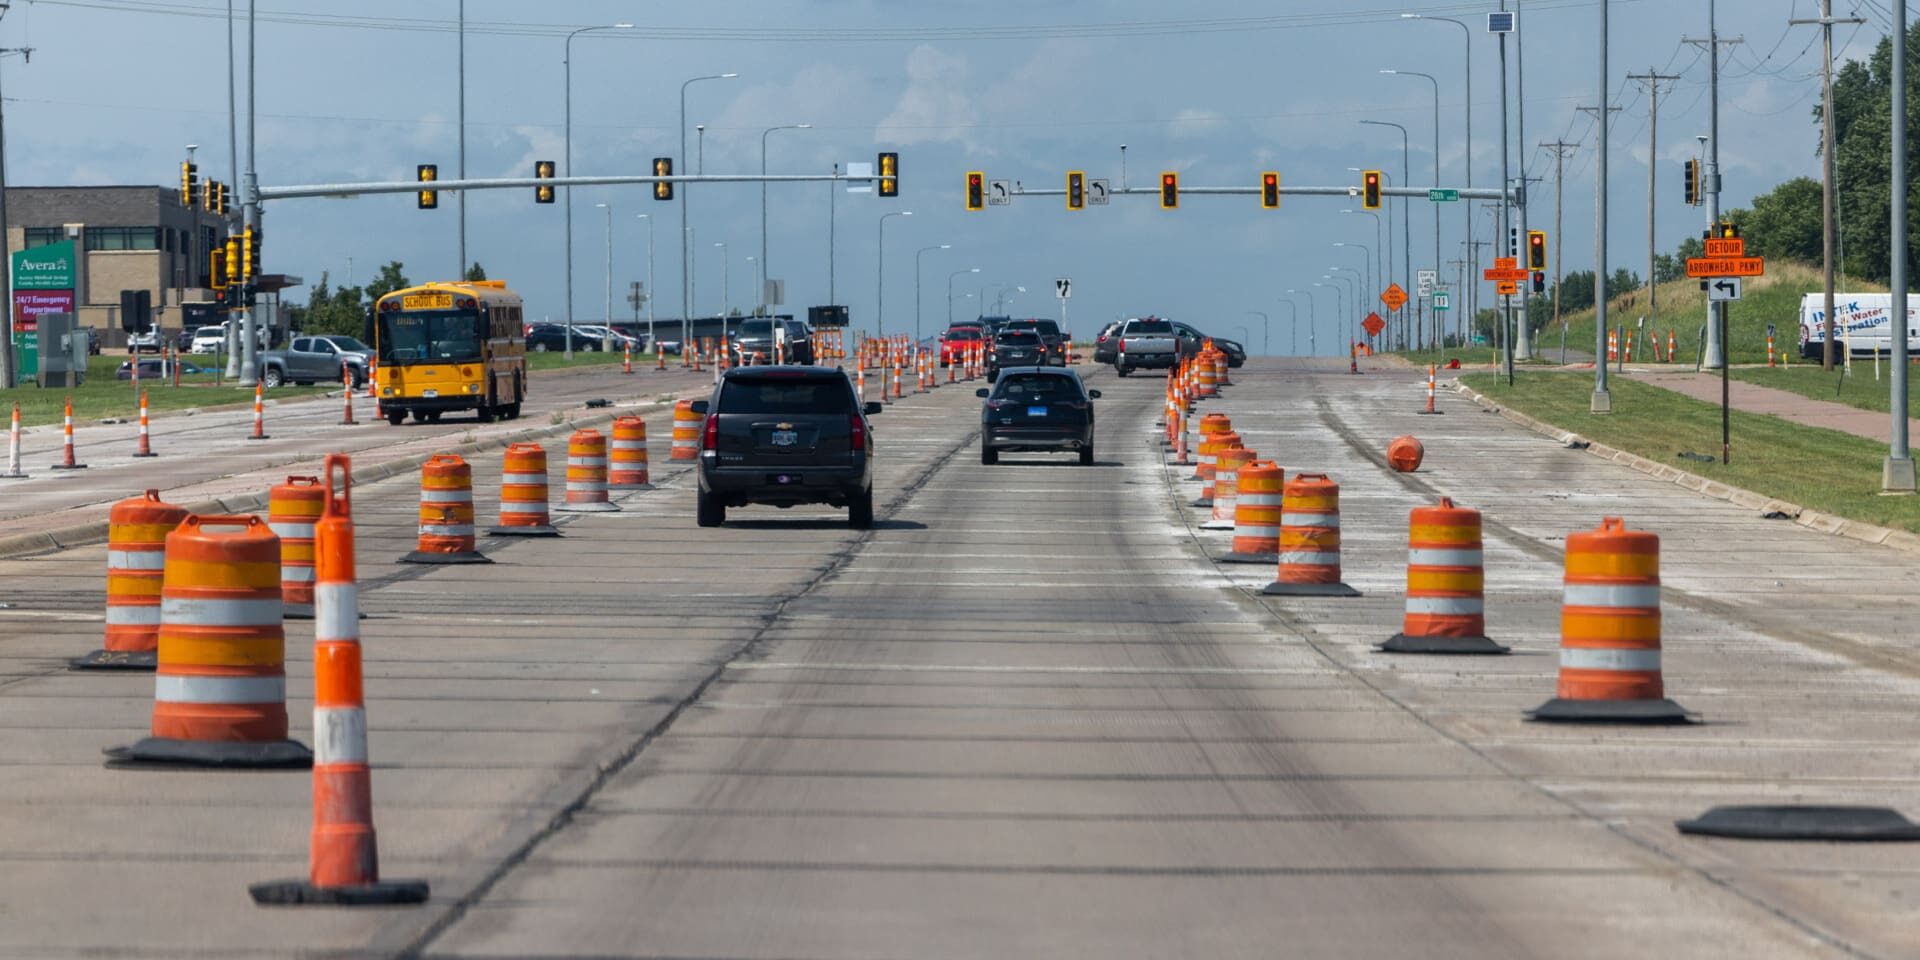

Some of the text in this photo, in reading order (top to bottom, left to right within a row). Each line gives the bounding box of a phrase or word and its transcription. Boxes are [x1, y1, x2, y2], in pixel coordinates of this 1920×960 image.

[1430, 191, 1444, 200] 26th
[1709, 242, 1740, 254] DETOUR
[20, 259, 56, 270] Avera
[1689, 261, 1760, 273] ARROWHEAD PKWY
[31, 295, 70, 304] Emergency
[405, 296, 451, 308] SCHOOL BUS
[1437, 297, 1445, 306] 11
[23, 306, 64, 314] Department
[1851, 307, 1883, 322] Water
